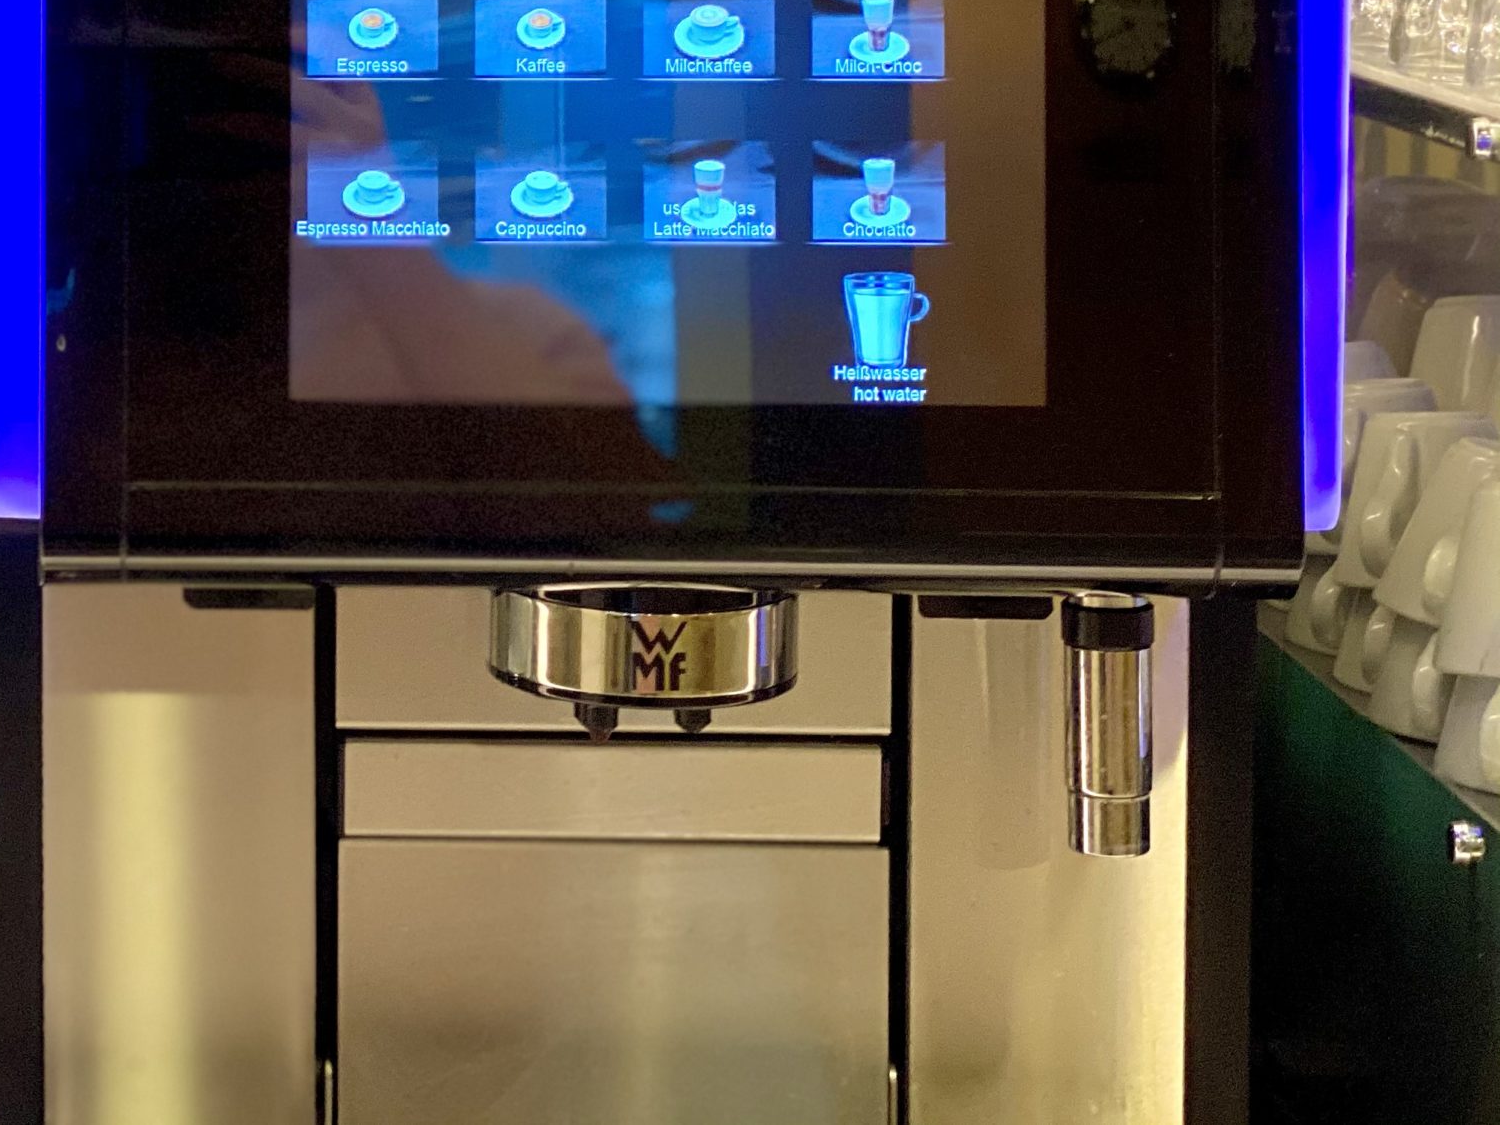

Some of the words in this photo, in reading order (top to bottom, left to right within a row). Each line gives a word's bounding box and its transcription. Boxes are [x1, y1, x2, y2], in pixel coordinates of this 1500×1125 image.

[336, 58, 408, 75] Espresso
[516, 58, 565, 73] Kaffee
[665, 58, 753, 73] Milchkaffee
[296, 221, 367, 238] Espresso
[371, 220, 451, 236] Macchiato
[495, 221, 586, 238] Cappuccino
[654, 221, 692, 236] Latte
[833, 365, 927, 381] Heißwasser
[853, 386, 880, 402] hot
[882, 386, 928, 402] water
